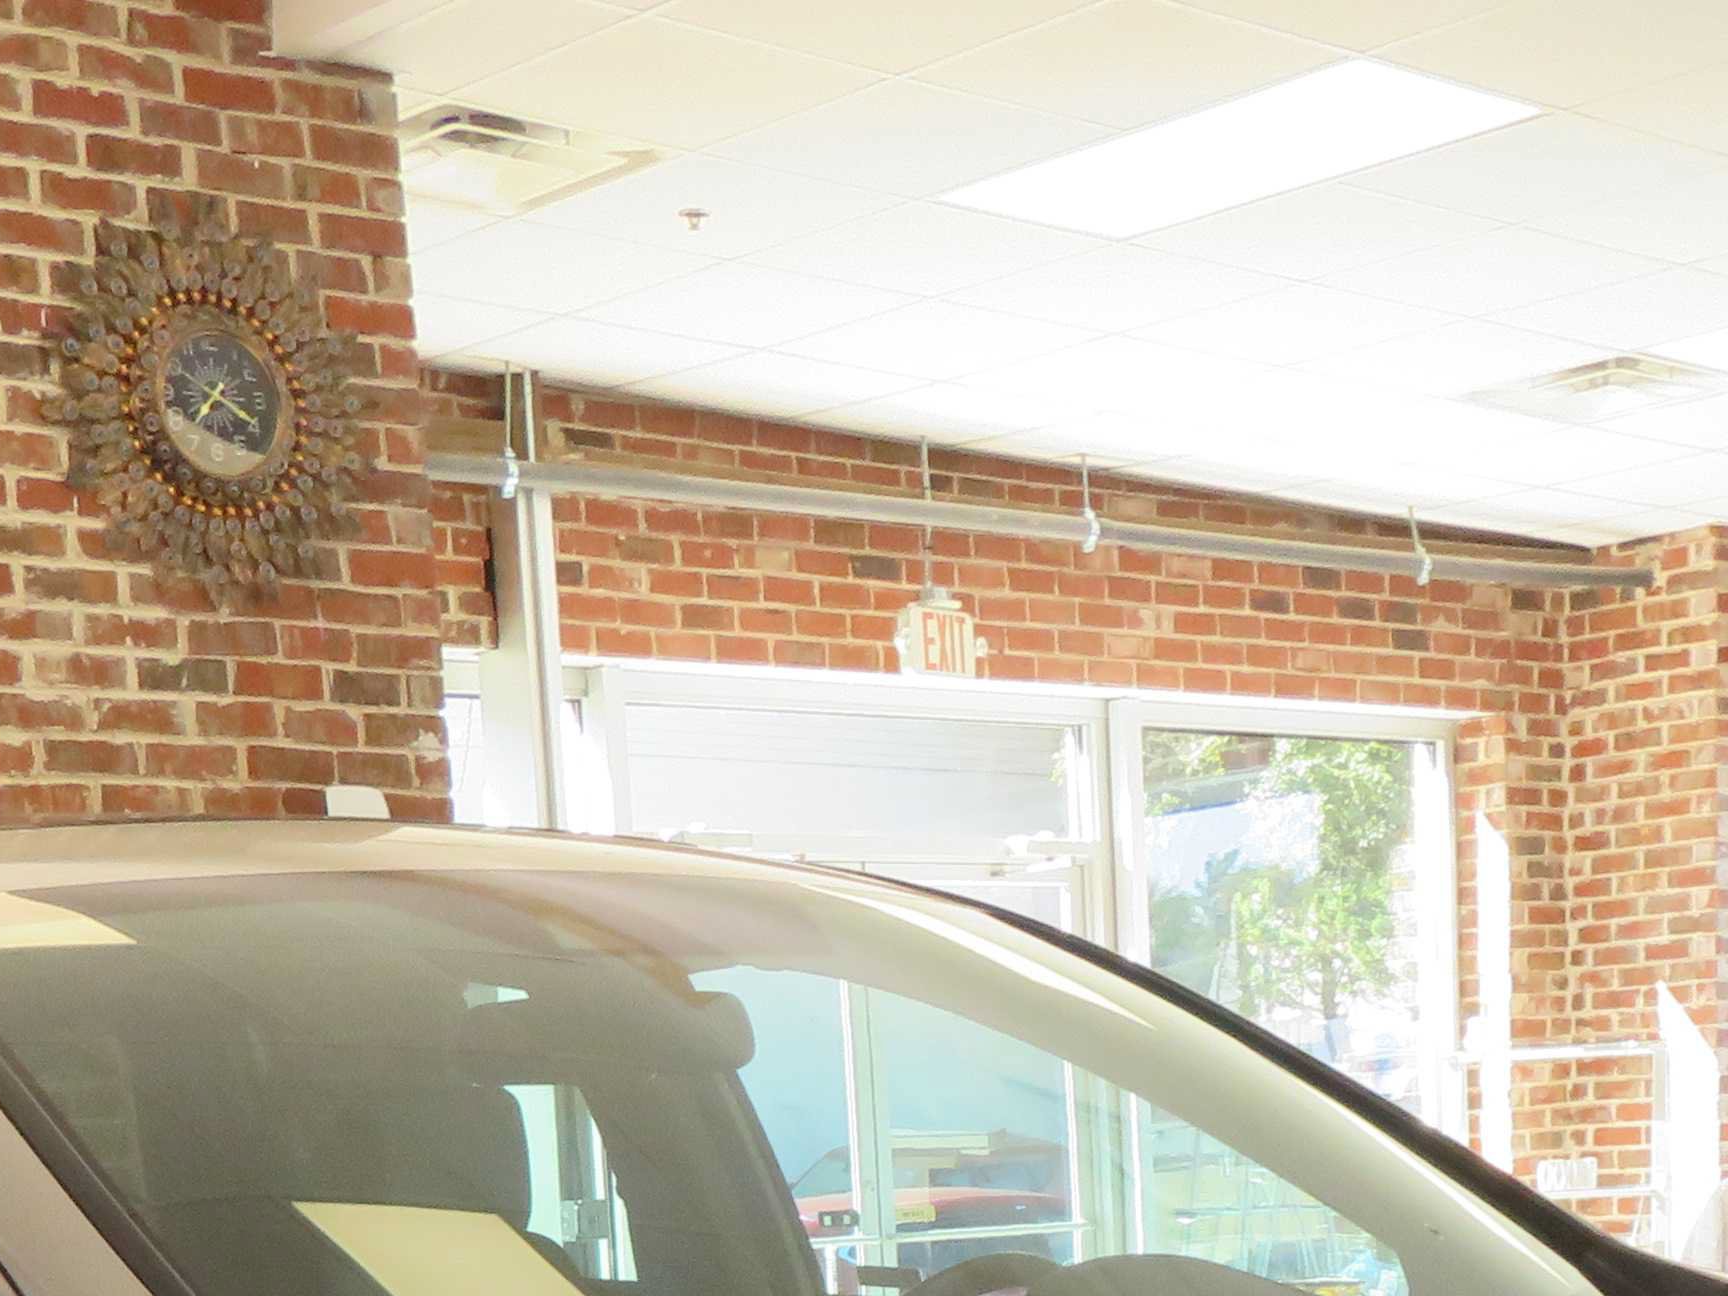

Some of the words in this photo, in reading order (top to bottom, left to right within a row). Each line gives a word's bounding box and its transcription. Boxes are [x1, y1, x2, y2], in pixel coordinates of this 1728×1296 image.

[187, 435, 200, 451] 7
[210, 442, 224, 462] 6
[922, 611, 967, 673] EXIT
